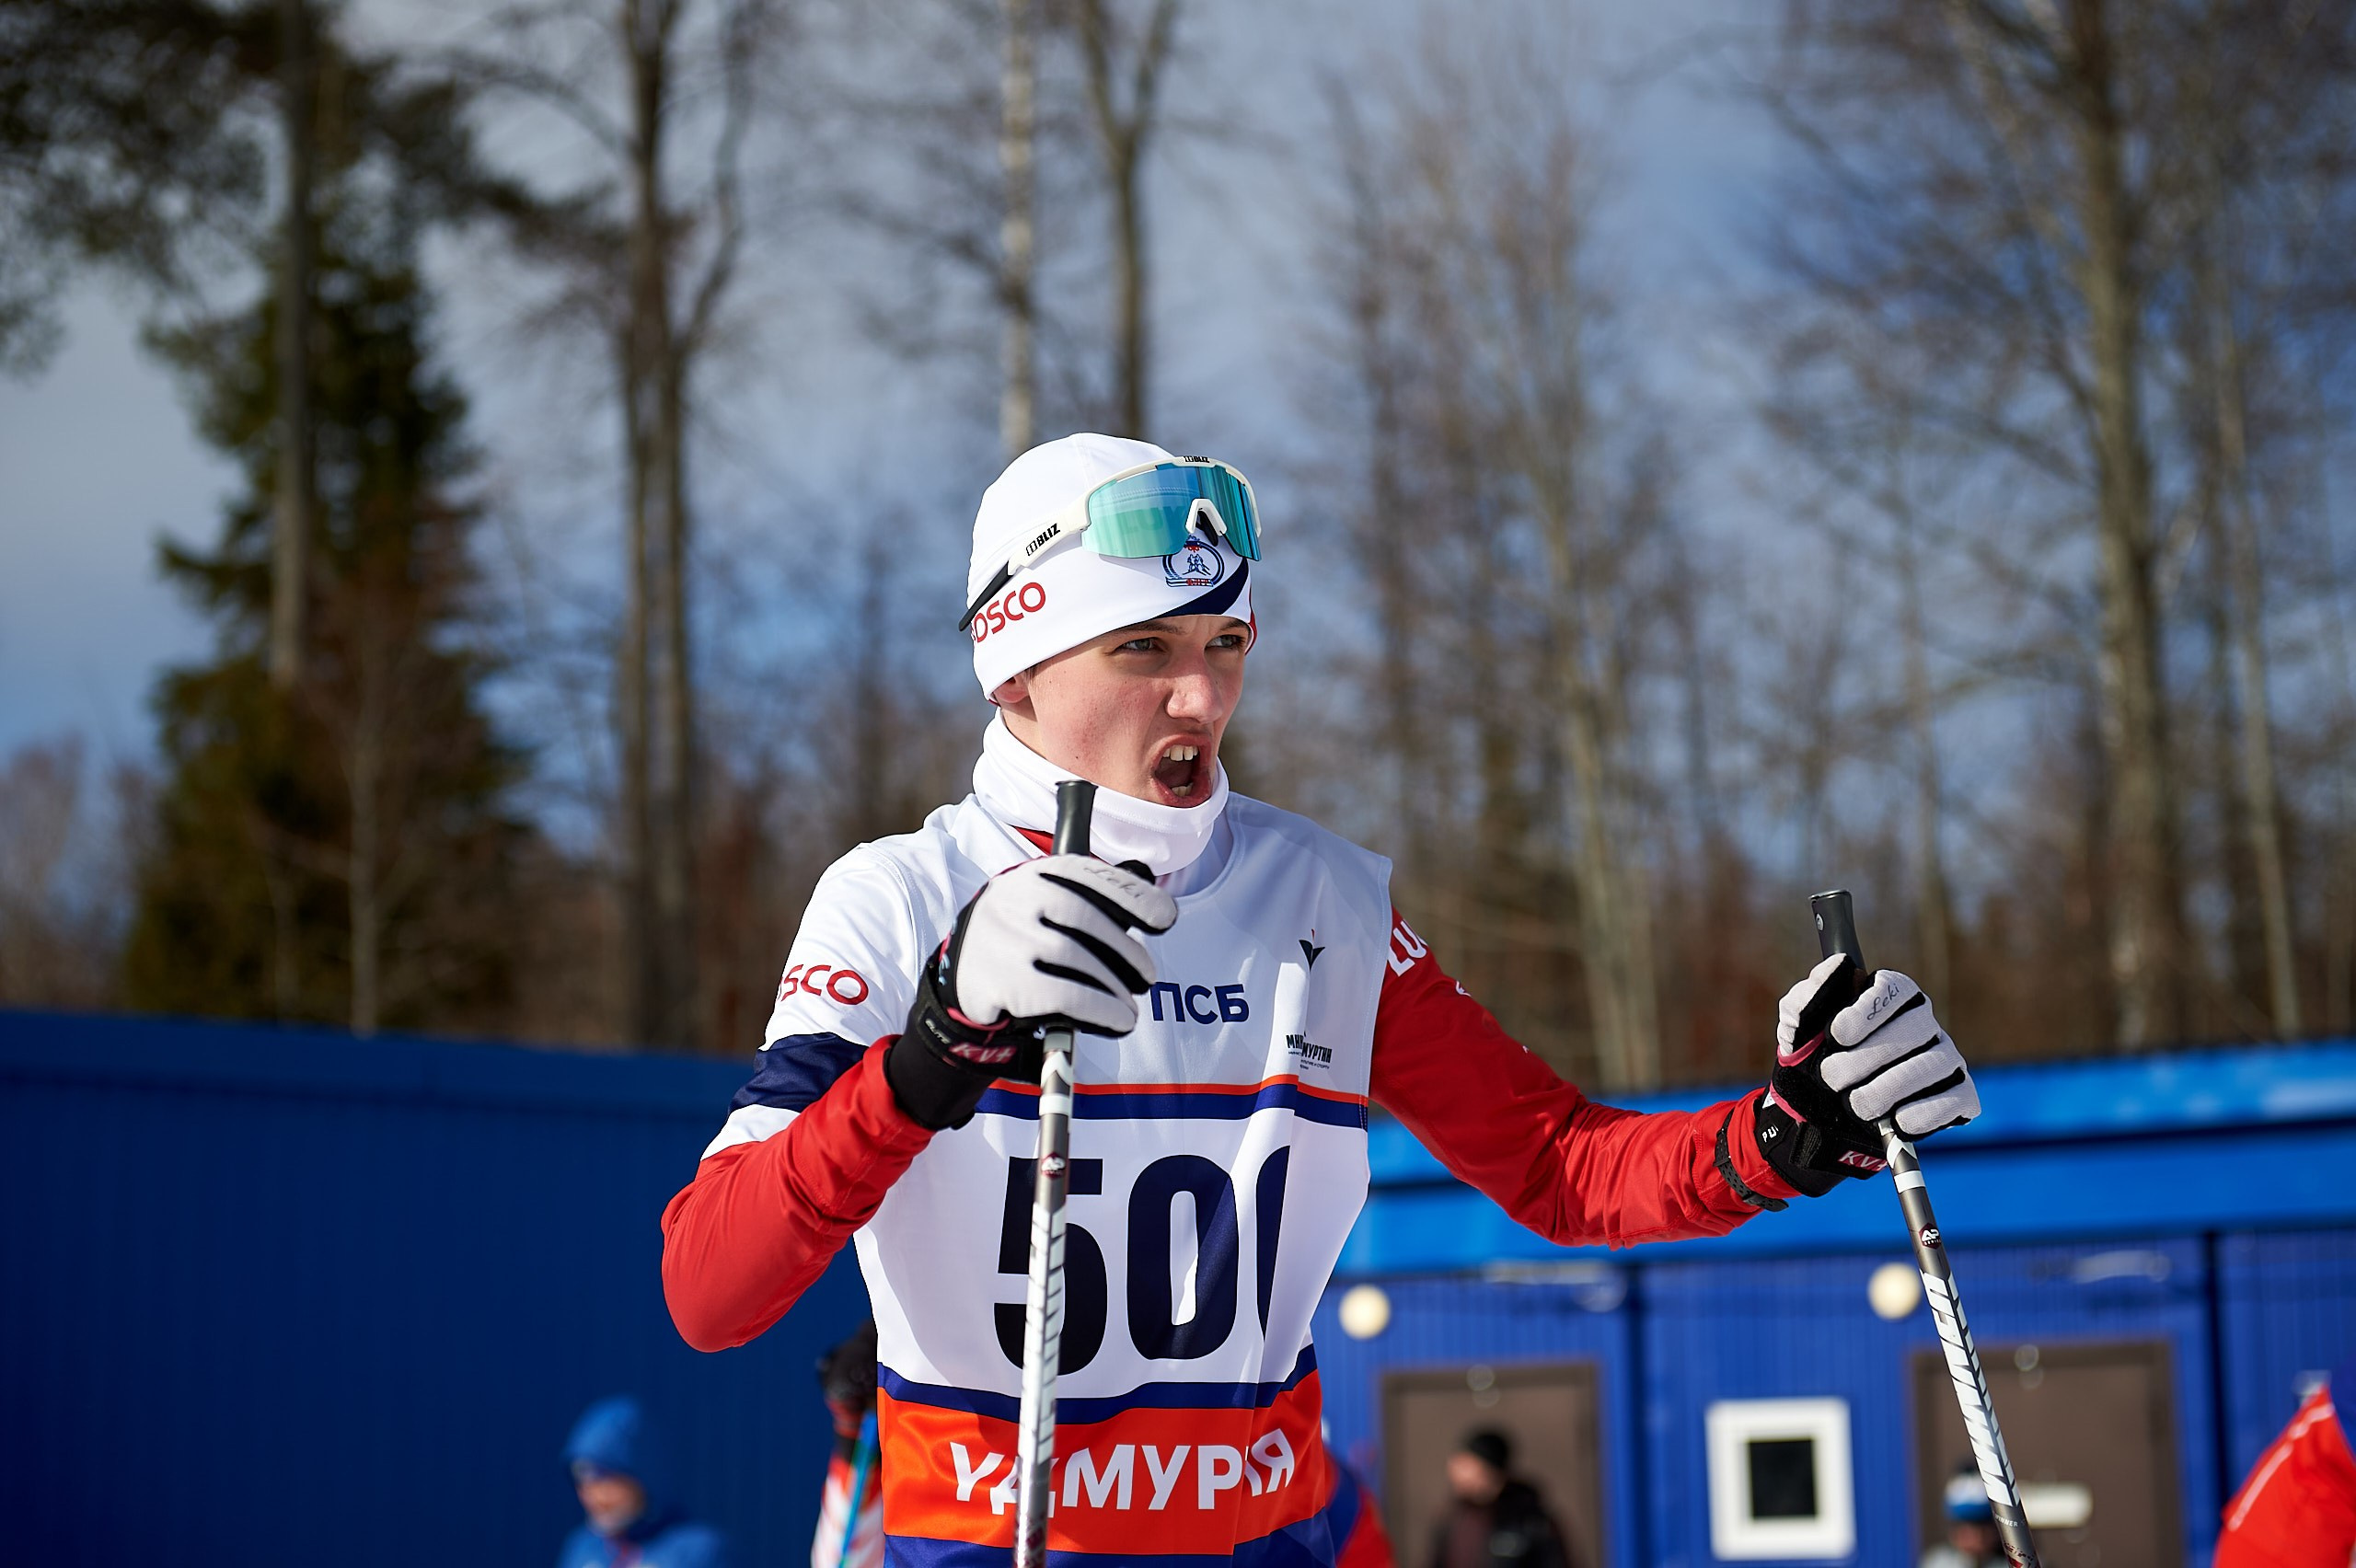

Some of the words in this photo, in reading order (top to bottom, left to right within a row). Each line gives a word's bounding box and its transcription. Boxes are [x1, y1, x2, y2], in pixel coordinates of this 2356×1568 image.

[1036, 523, 1061, 548] BLIZ
[971, 582, 1046, 643] OSCO
[1388, 918, 1427, 977] LU
[777, 964, 870, 1006] SCO
[1149, 981, 1250, 1025] ПСБ
[1866, 983, 1900, 1020] Leki
